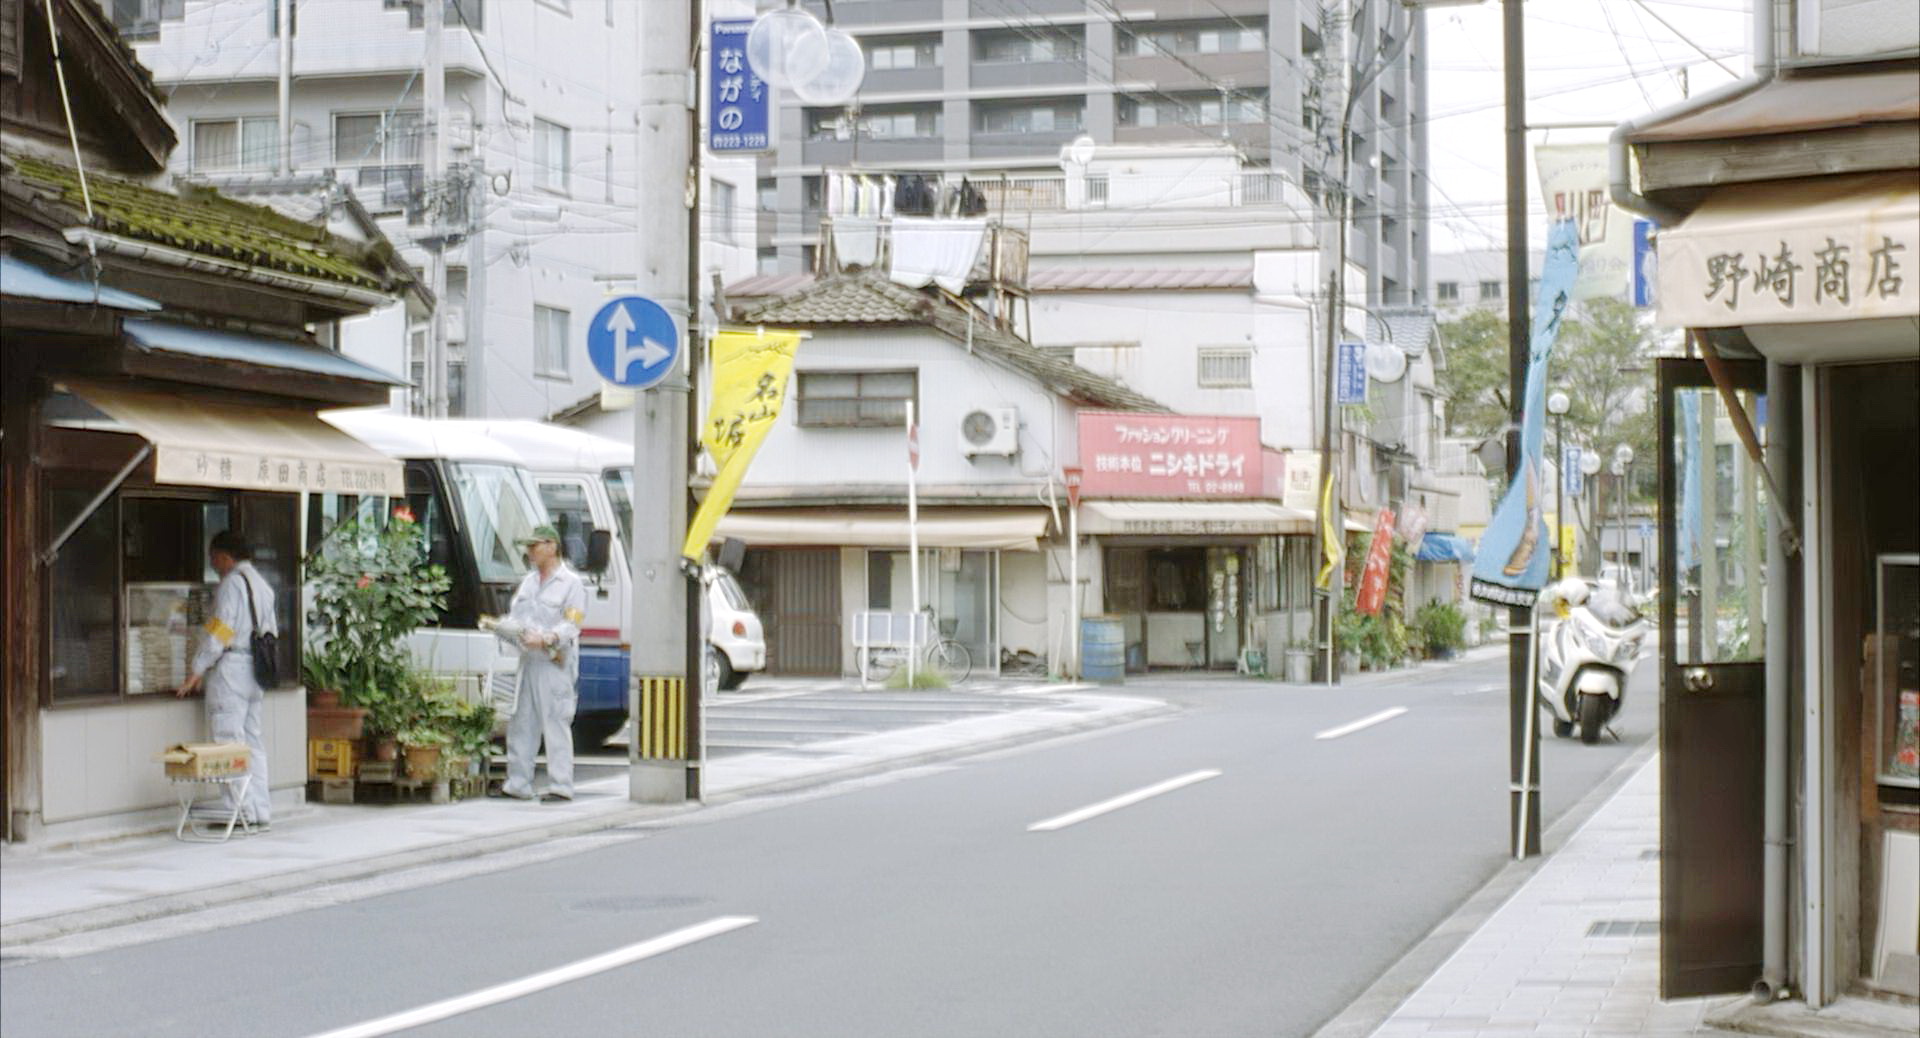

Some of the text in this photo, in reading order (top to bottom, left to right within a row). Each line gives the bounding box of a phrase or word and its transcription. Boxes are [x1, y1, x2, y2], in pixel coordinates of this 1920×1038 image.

[719, 47, 744, 131] ながの
[1704, 236, 1907, 311] 野崎商店
[1115, 424, 1230, 445] ファッションクリーニング
[1149, 452, 1245, 477] ニシキドライ
